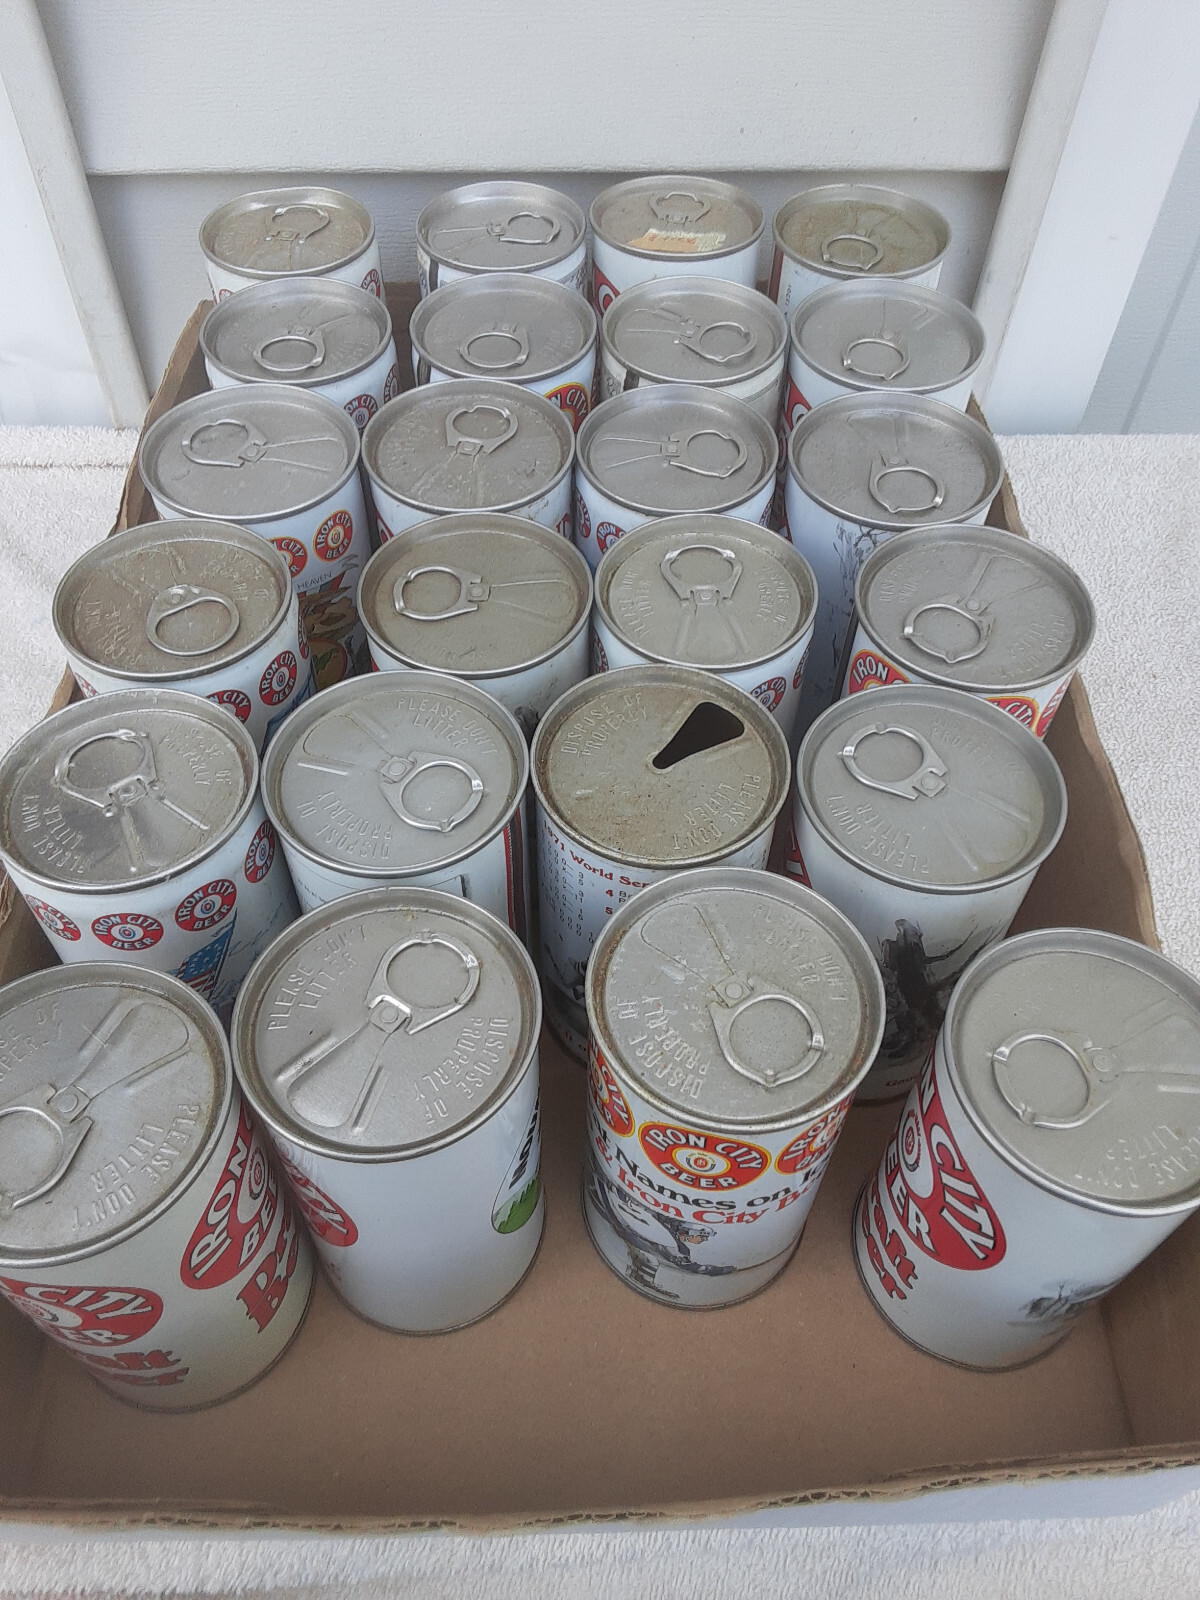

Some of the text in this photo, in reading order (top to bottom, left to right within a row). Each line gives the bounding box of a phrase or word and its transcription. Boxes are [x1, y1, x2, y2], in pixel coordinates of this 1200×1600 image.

[361, 395, 377, 412] CITY
[567, 389, 587, 416] CITY
[282, 539, 305, 557] CITY
[317, 512, 351, 549] IRON CITY
[326, 537, 350, 559] BEER
[598, 523, 616, 540] IRON
[297, 572, 332, 590] HEAVEN
[262, 651, 297, 696] IRON CITY
[272, 677, 295, 703] BEER
[769, 678, 787, 695] CITY
[853, 655, 889, 686] IRON
[222, 690, 249, 708] CITY
[397, 698, 499, 756] PLEASE DON'T
[413, 713, 471, 750] LITTER
[560, 701, 611, 757] DISPOSE
[316, 790, 394, 842] PROPERLY
[672, 772, 763, 852] PLEASE DON'T
[685, 781, 737, 827] LITTER
[314, 822, 391, 861] DISPOSE
[855, 803, 912, 849] LITTER
[246, 835, 259, 875] IRON
[569, 849, 615, 882] World
[860, 836, 931, 875] PLEASE
[47, 906, 78, 931] CITY
[178, 880, 235, 922] IRON CITY
[194, 904, 231, 931] BEER
[94, 914, 161, 937] IRON CITY
[112, 936, 156, 950] BEER
[267, 964, 314, 1031] PLEASE
[298, 952, 359, 1011] LITTER
[465, 1016, 510, 1100] DISPOSE
[601, 1065, 629, 1126] CITY
[644, 1128, 763, 1169] IRON CITY
[783, 1106, 841, 1161] IRON
[71, 1103, 200, 1231] PLEASE DON'T
[90, 1122, 165, 1194] LITTER
[615, 1143, 792, 1210] Names on
[660, 1162, 739, 1188] BEER
[189, 1135, 248, 1280] IRON
[617, 1165, 685, 1219] Iron
[693, 1207, 770, 1225] City
[887, 1138, 937, 1254] EER
[930, 1122, 996, 1261] CITY
[239, 1168, 277, 1268] BEE
[24, 1286, 153, 1321] CITY
